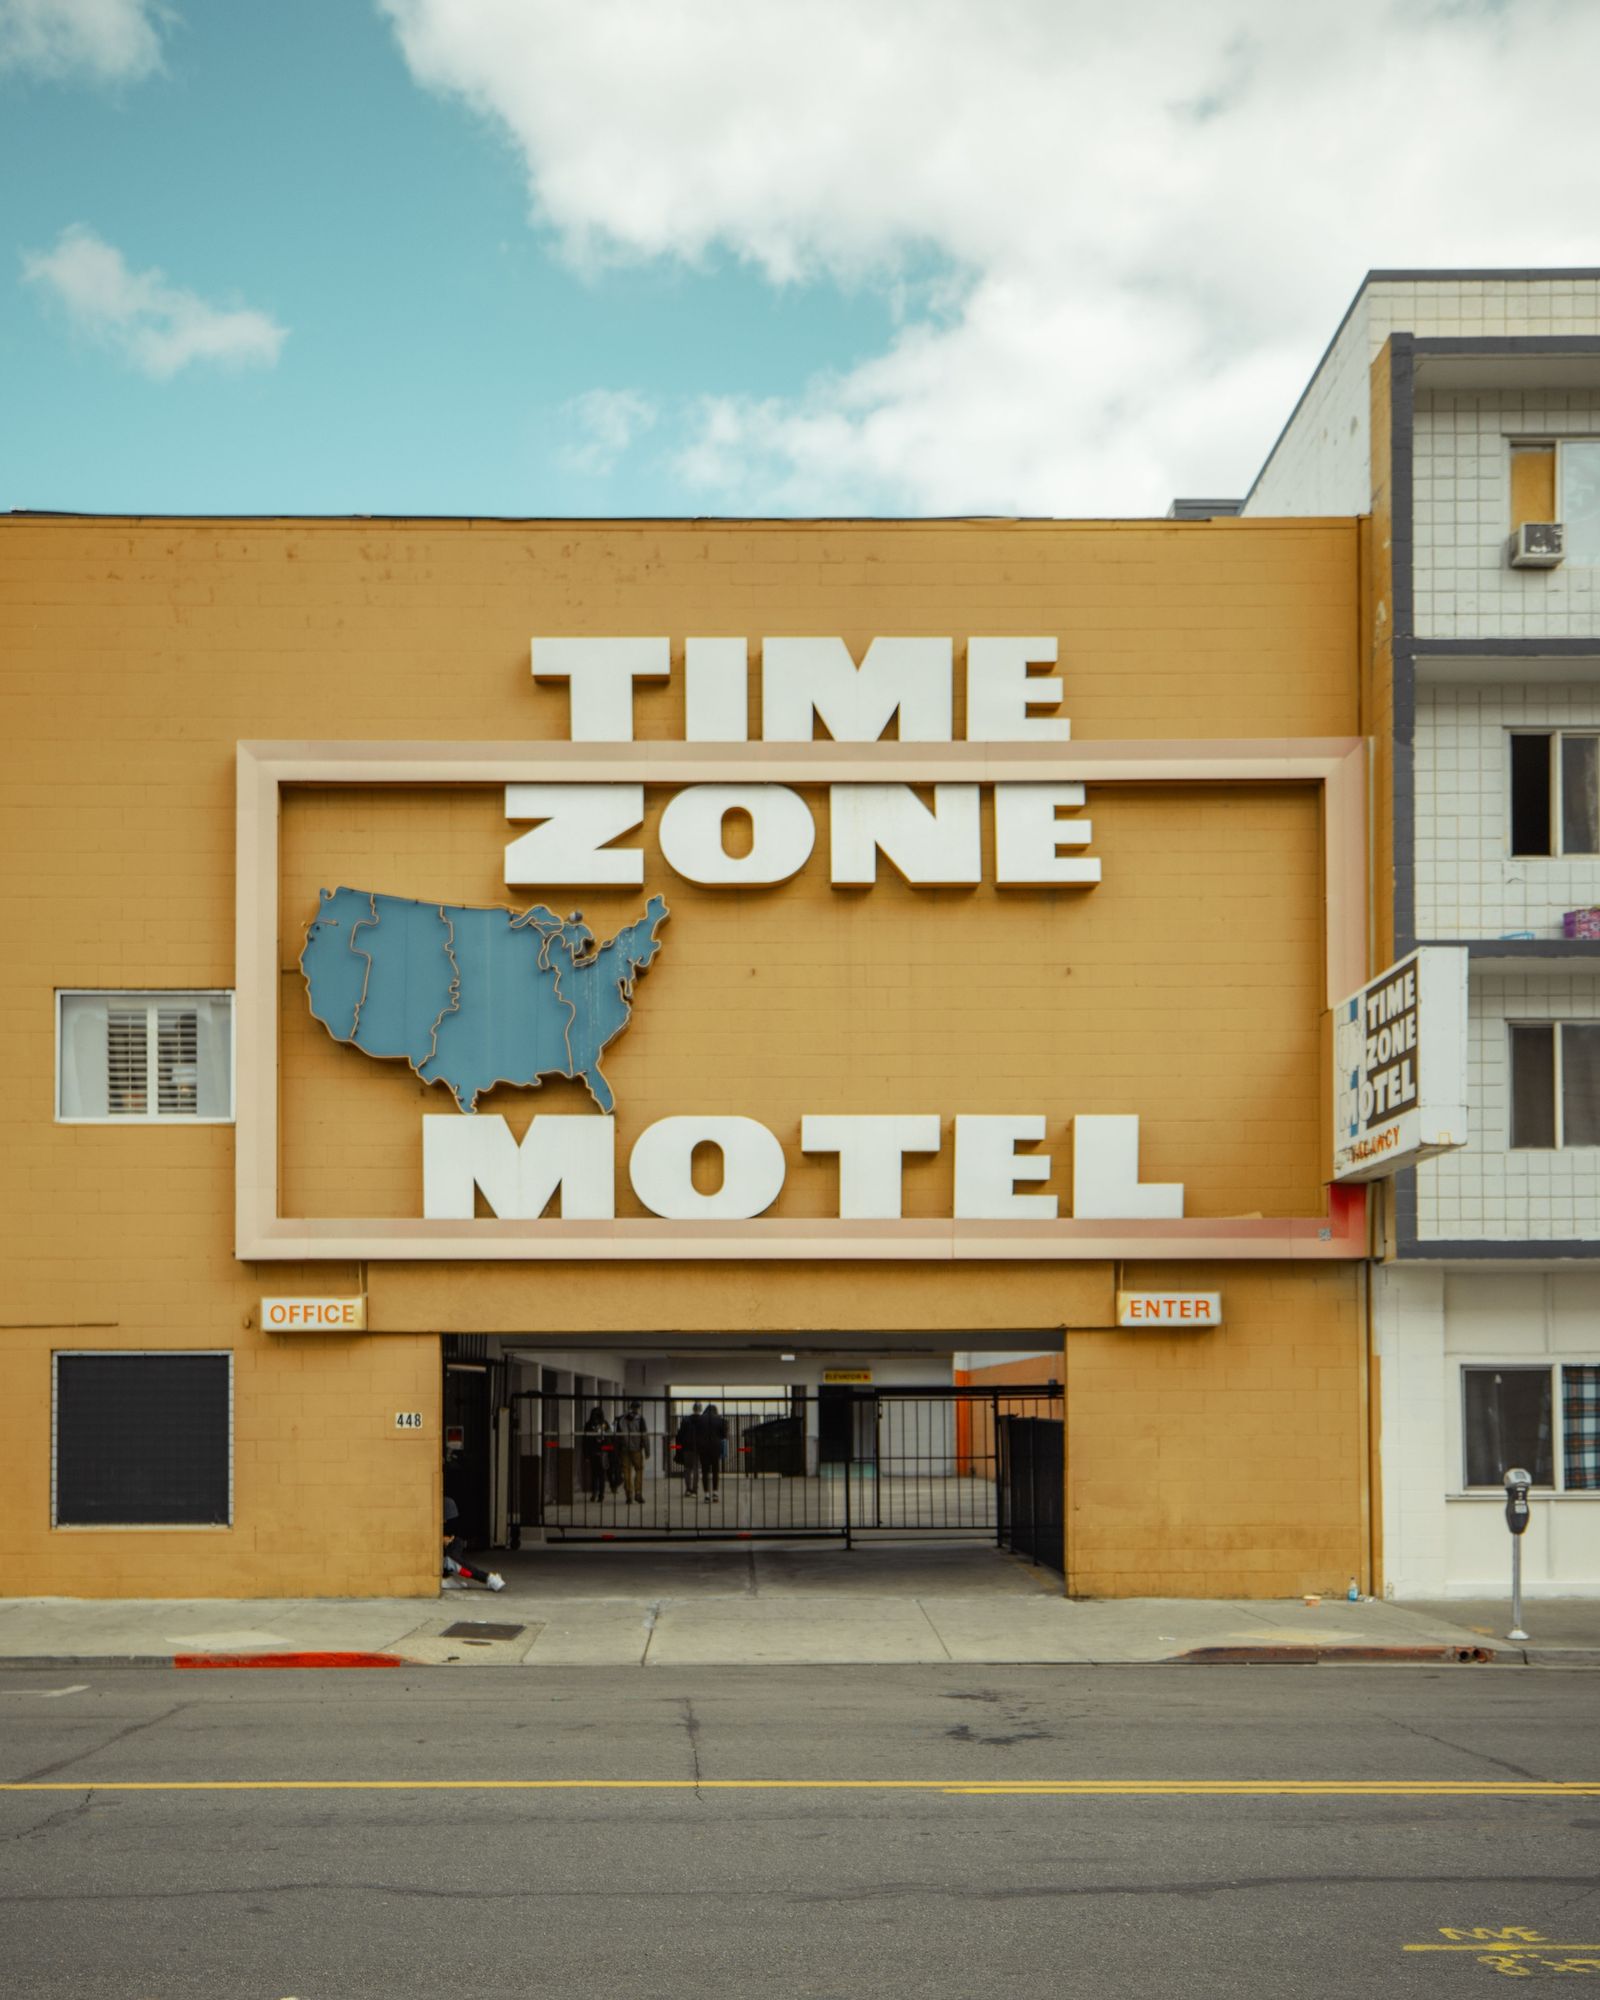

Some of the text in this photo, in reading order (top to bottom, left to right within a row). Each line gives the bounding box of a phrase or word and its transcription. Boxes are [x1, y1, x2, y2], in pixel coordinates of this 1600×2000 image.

[531, 636, 1071, 742] TIME
[504, 783, 1101, 885] ZONE
[1367, 970, 1415, 1030] TIME
[1366, 1011, 1417, 1069] ZONE
[1339, 1058, 1416, 1132] MOTEL
[422, 1114, 1184, 1219] MOTEL
[269, 1304, 355, 1324] OFFICE
[1130, 1299, 1211, 1318] ENTER
[396, 1412, 422, 1428] 448
